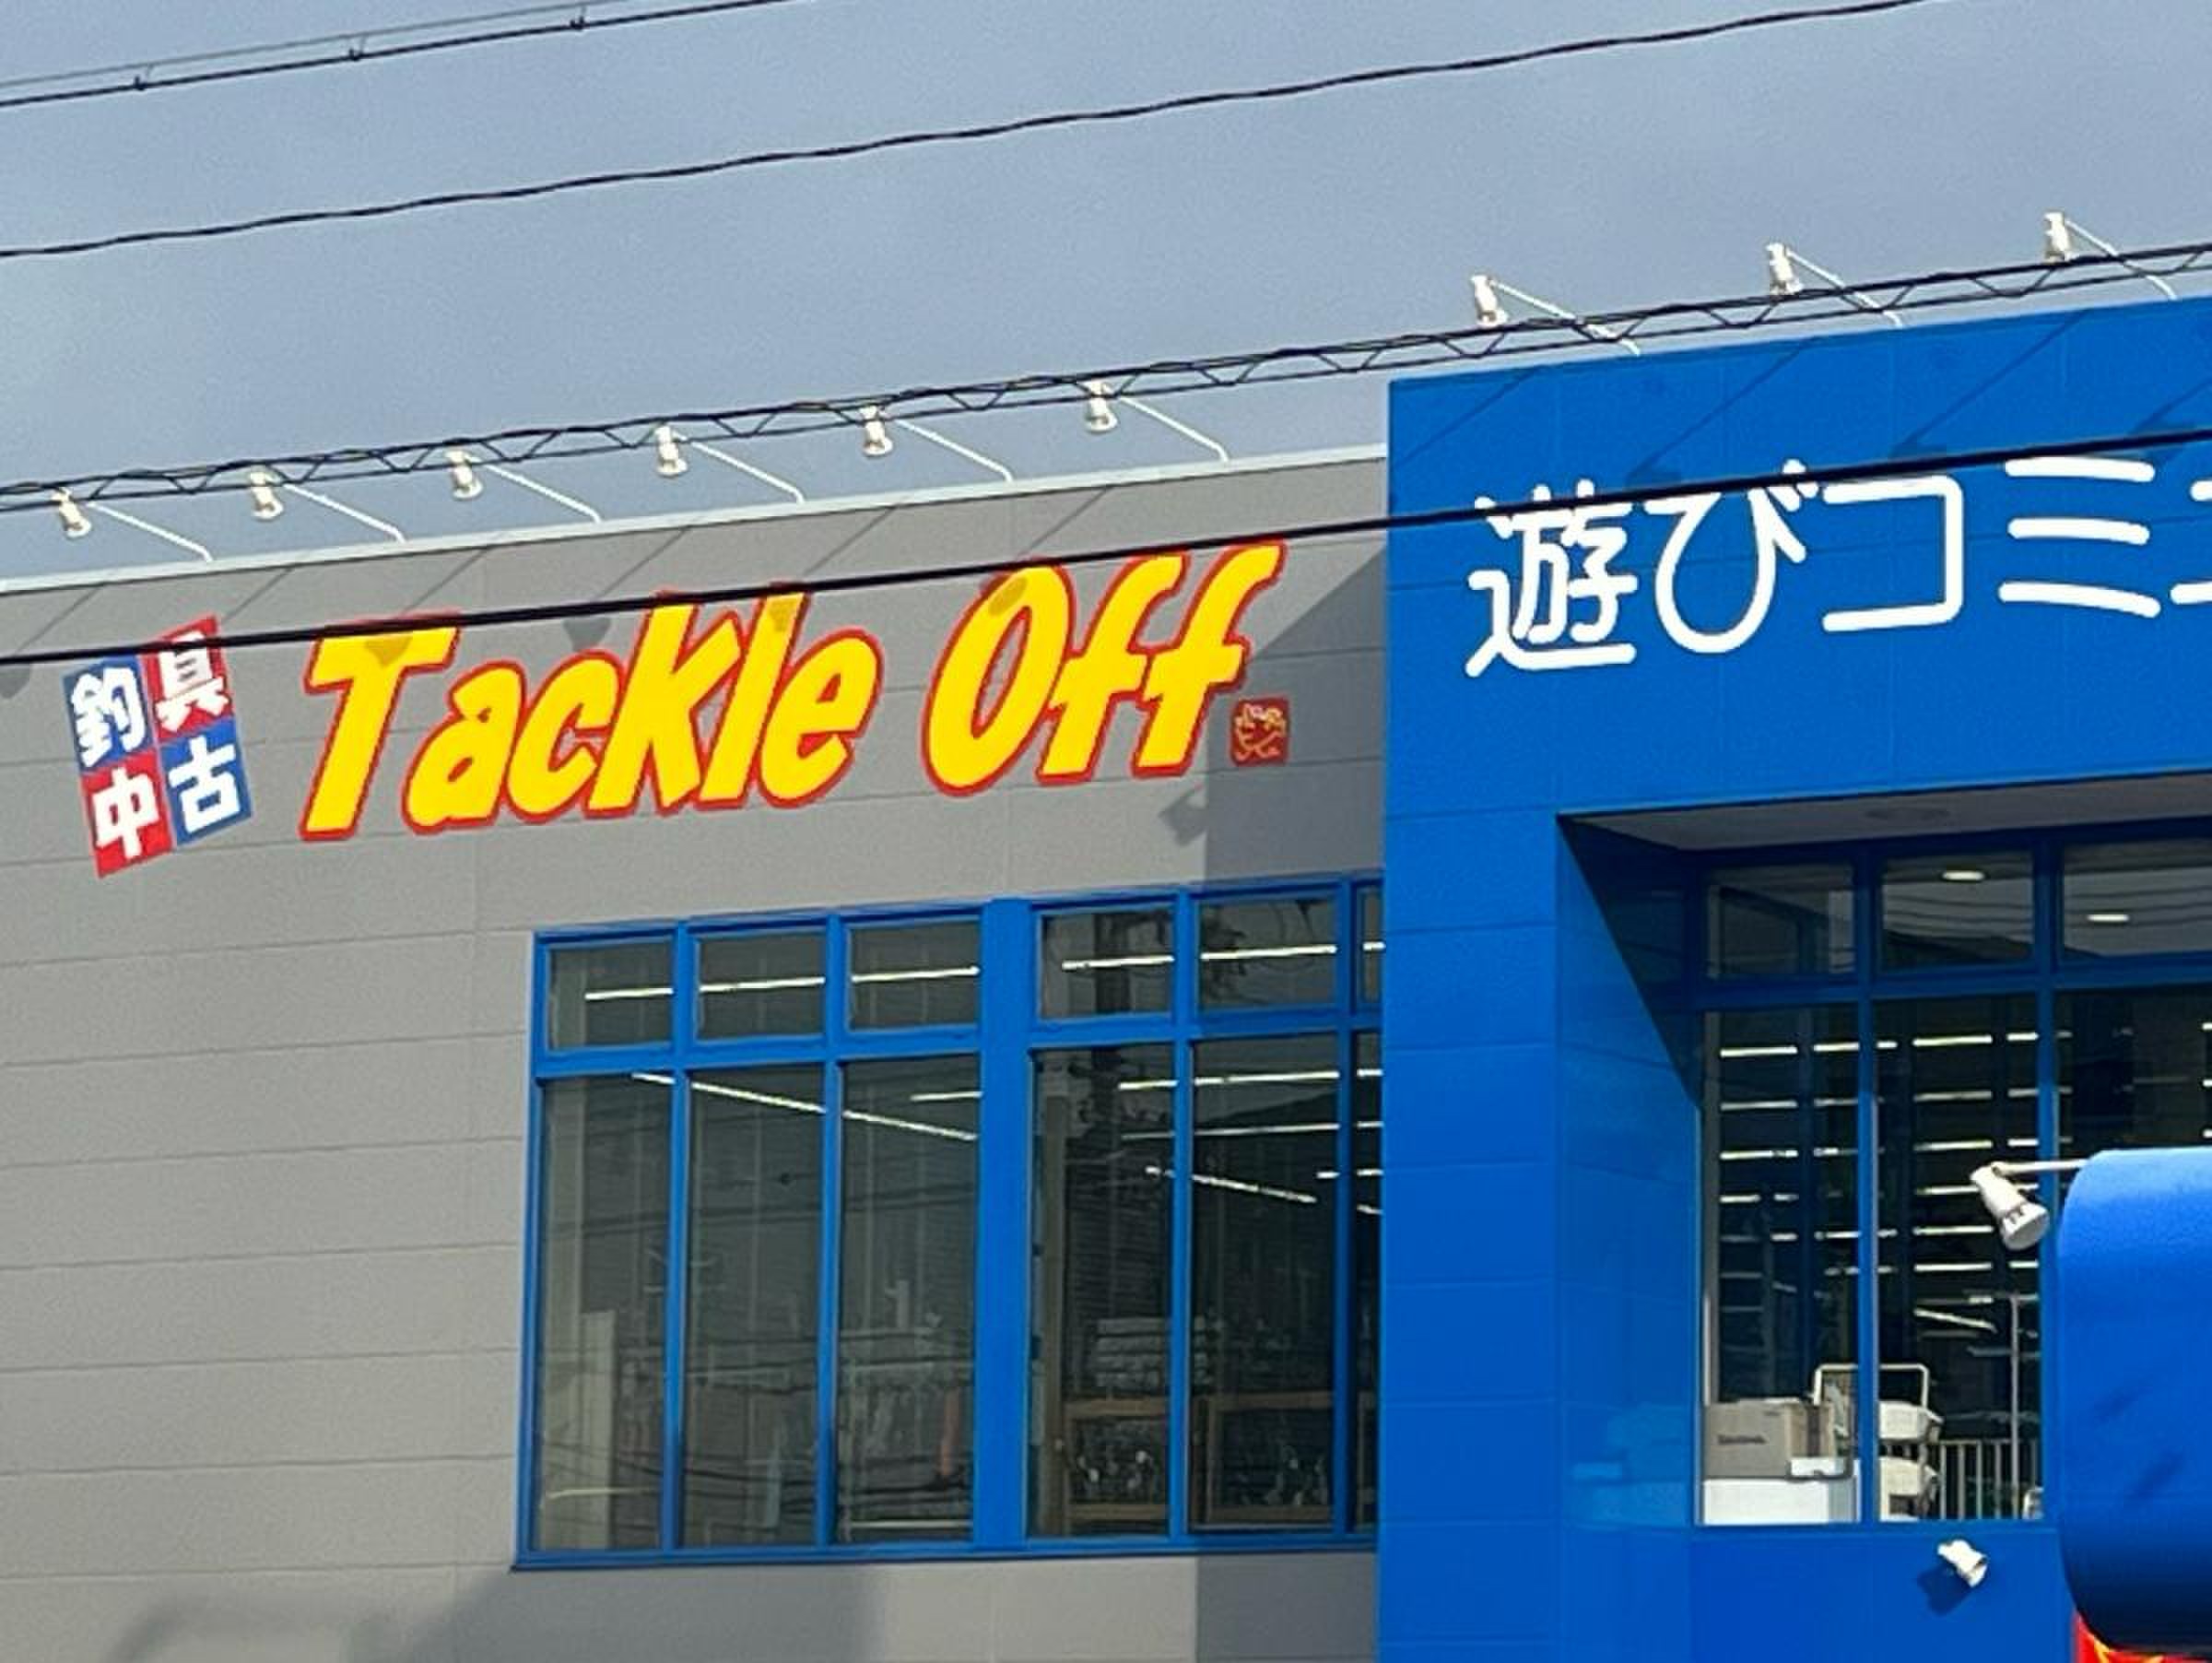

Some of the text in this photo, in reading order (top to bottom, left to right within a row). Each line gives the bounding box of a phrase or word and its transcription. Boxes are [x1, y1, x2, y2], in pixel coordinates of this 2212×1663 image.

[1466, 458, 2212, 678] 遊びコミ
[71, 631, 231, 767] 釣具
[297, 537, 1287, 841] Tackle Off
[93, 736, 240, 859] 中古
